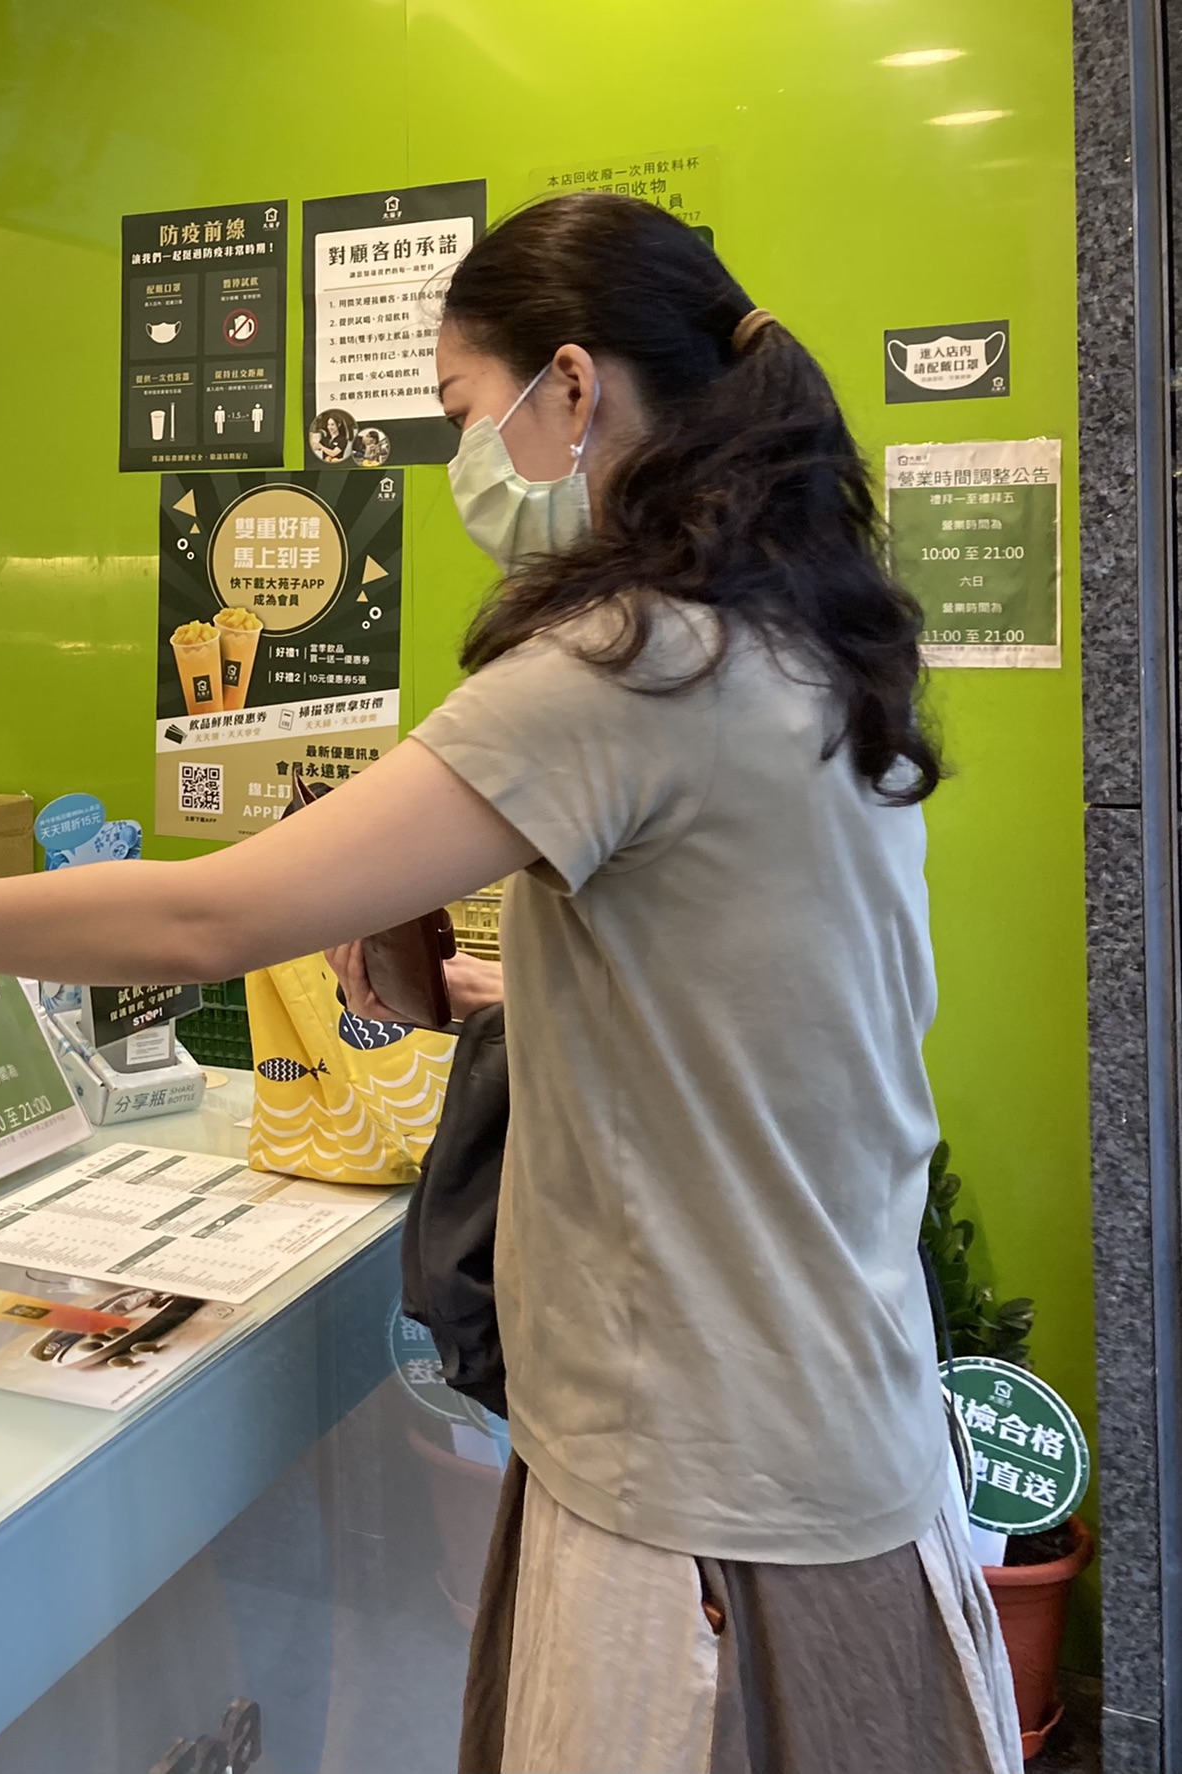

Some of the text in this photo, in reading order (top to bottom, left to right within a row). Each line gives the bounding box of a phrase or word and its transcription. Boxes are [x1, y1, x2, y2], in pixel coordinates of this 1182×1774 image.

[159, 218, 246, 247] 防疫前線
[329, 233, 458, 266] 對顧客的承諾
[919, 345, 972, 360] 進入店內
[914, 358, 979, 375] 請配戴口罩
[898, 467, 1050, 487] 營業時間調整公告
[930, 492, 1015, 505] 禮拜一至禮拜五
[234, 516, 321, 540] 雙重好禮
[942, 519, 1002, 531] 營業時間為
[233, 546, 321, 569] 馬上到手
[921, 546, 1024, 560] 10:00 至 21:00
[230, 577, 324, 590] 快下載大苑子APP
[959, 576, 983, 587] 六日
[253, 594, 299, 606] 成為會員
[942, 602, 1002, 614] 營業時間為
[923, 629, 1024, 643] 11:00 至 21:00
[275, 643, 344, 658] 好禮1 當季飲品
[309, 653, 370, 665] 買一送一優惠券
[275, 671, 367, 685] 好禮2 10元優惠券5張
[298, 697, 384, 719] 掃描發票拿好禮
[189, 711, 267, 731] 飲品鮮果優惠券
[306, 745, 380, 760] 最新優惠訊息
[40, 812, 102, 840] 天天現折15元
[114, 1084, 195, 1114] 分享瓶 SHARE
[168, 1093, 196, 1104] BOTTLE
[3, 1107, 22, 1129] 至
[18, 1095, 52, 1122] 21:00
